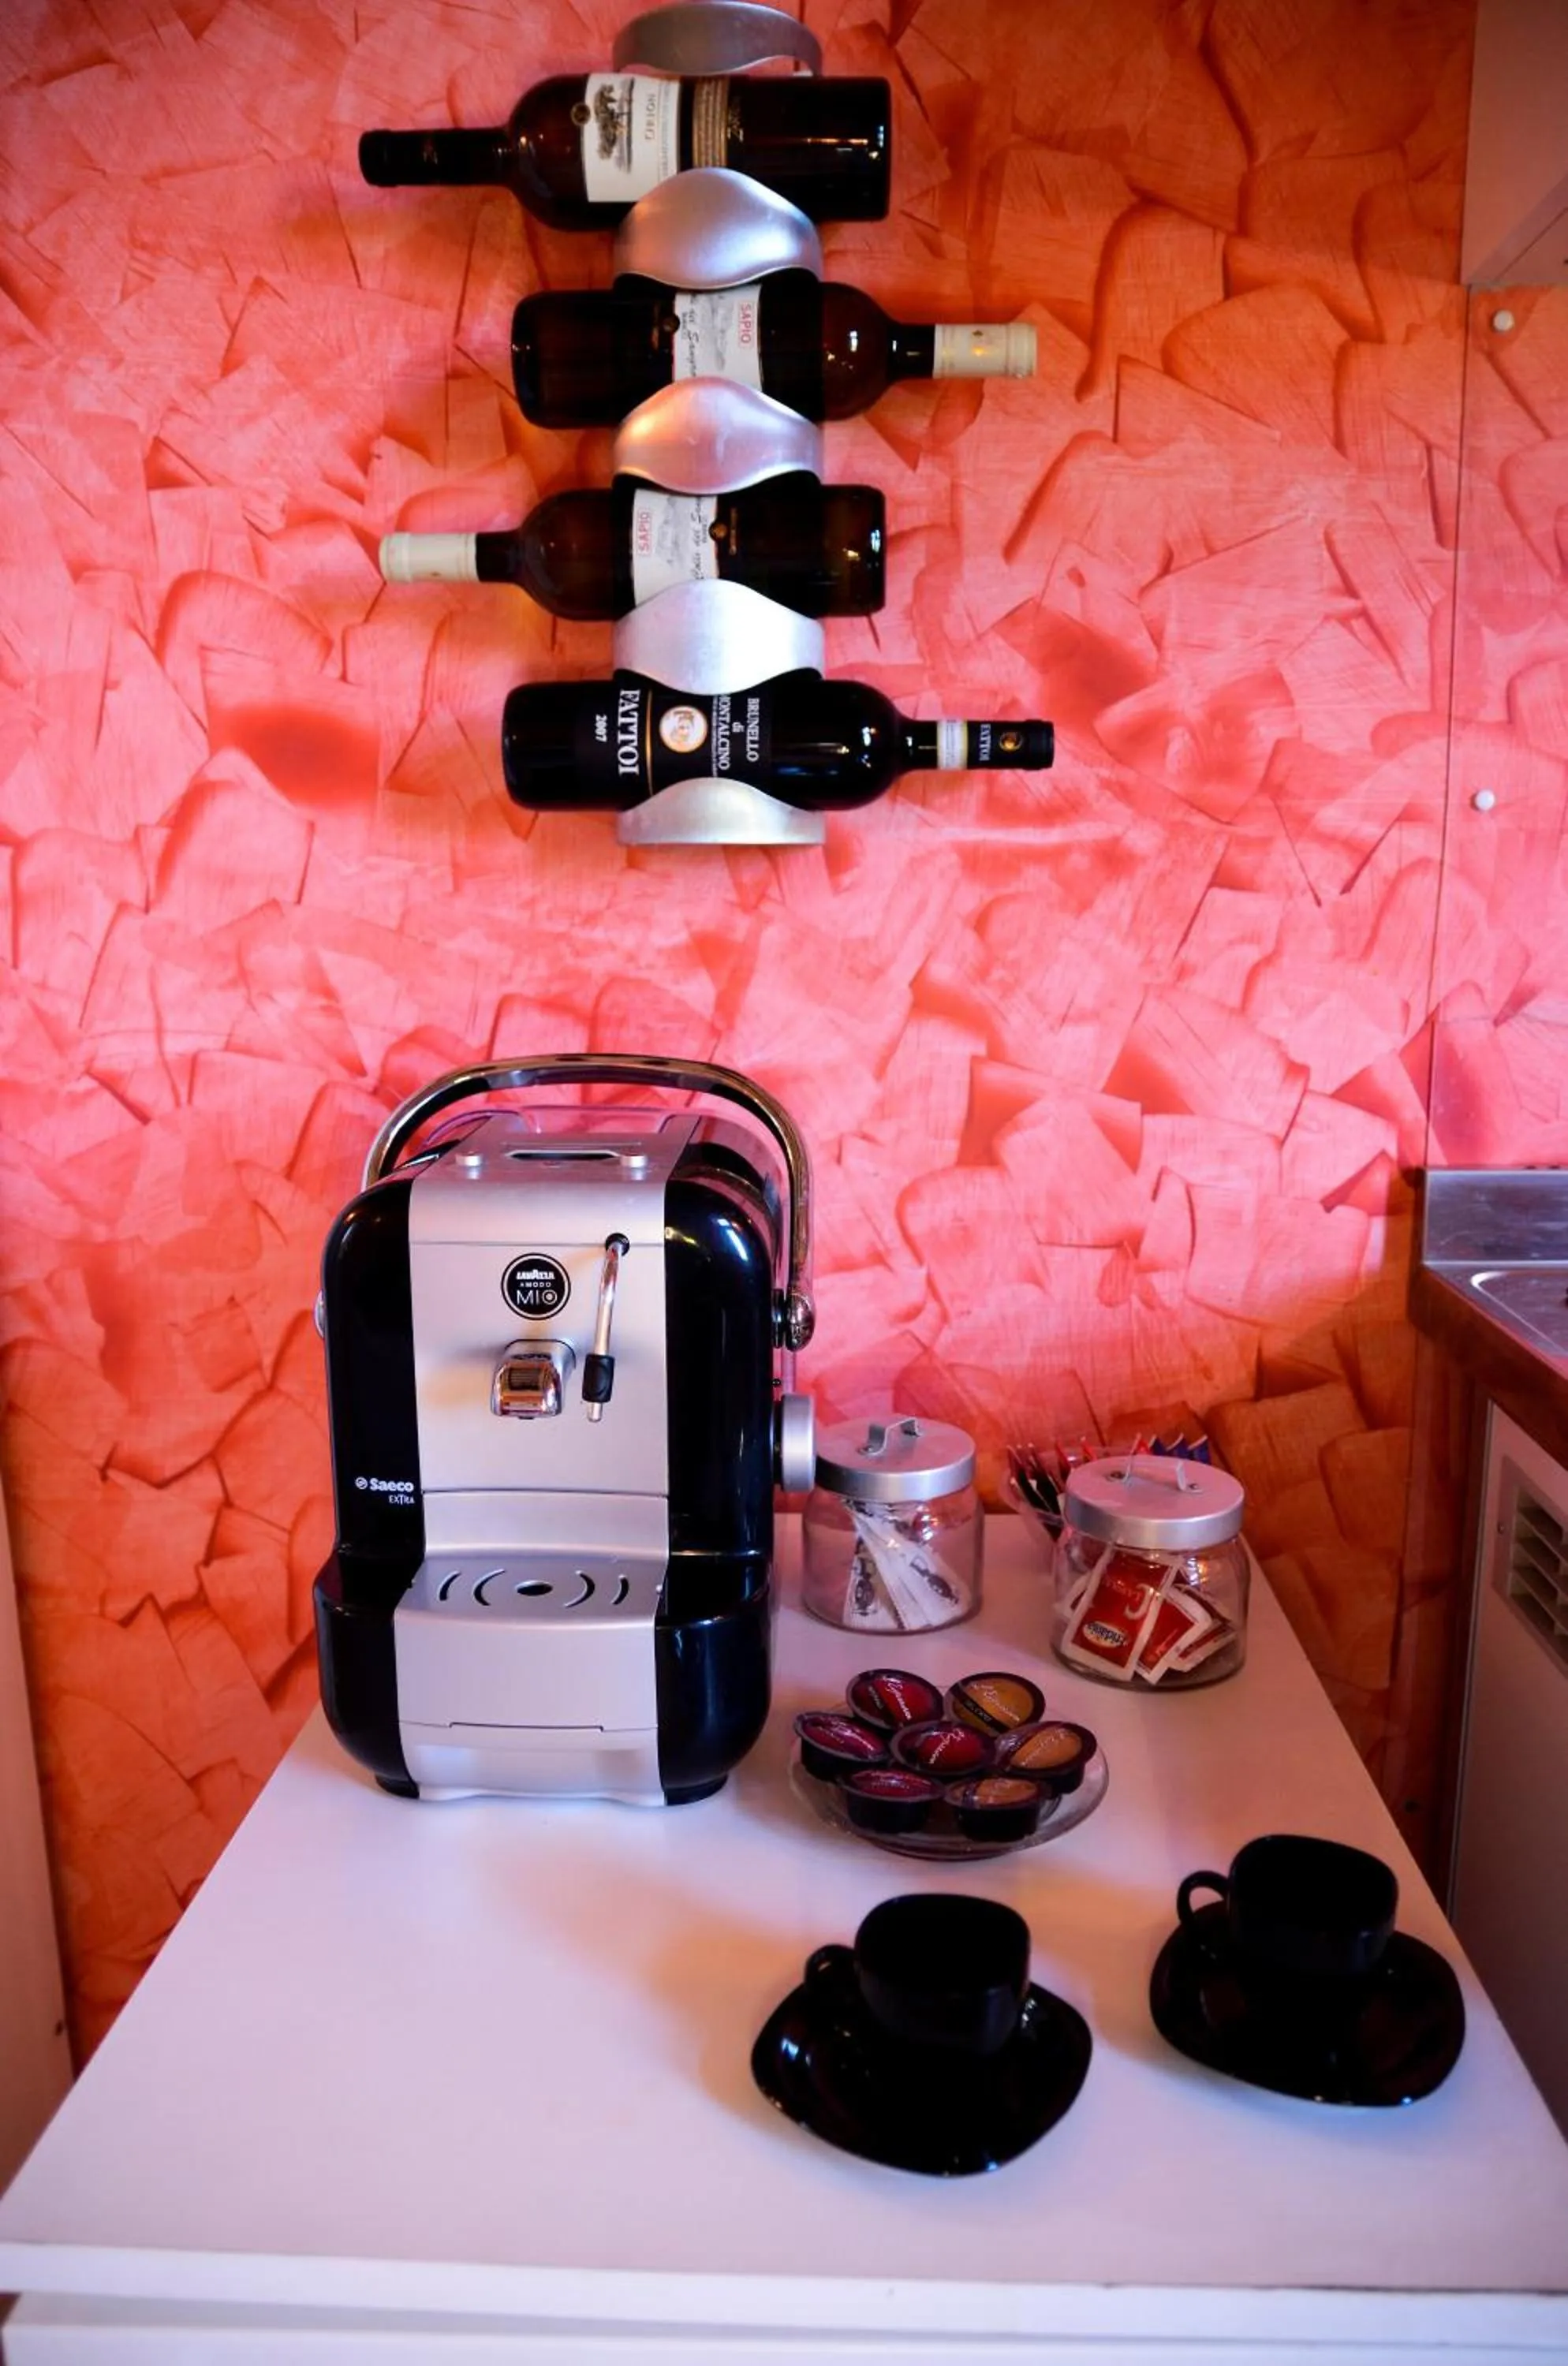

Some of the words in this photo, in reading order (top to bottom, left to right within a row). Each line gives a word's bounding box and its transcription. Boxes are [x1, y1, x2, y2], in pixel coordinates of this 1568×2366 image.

[741, 304, 752, 344] SAPIO
[638, 512, 650, 552] SAPIO
[595, 714, 607, 742] 2007
[618, 689, 640, 776] FATTOI
[732, 721, 745, 733] di
[746, 697, 760, 762] BRUNELLO
[517, 1269, 555, 1280] LAVAZZA
[517, 1289, 558, 1305] MIO
[369, 1477, 414, 1493] Saeco
[388, 1494, 416, 1506] EXTRA
